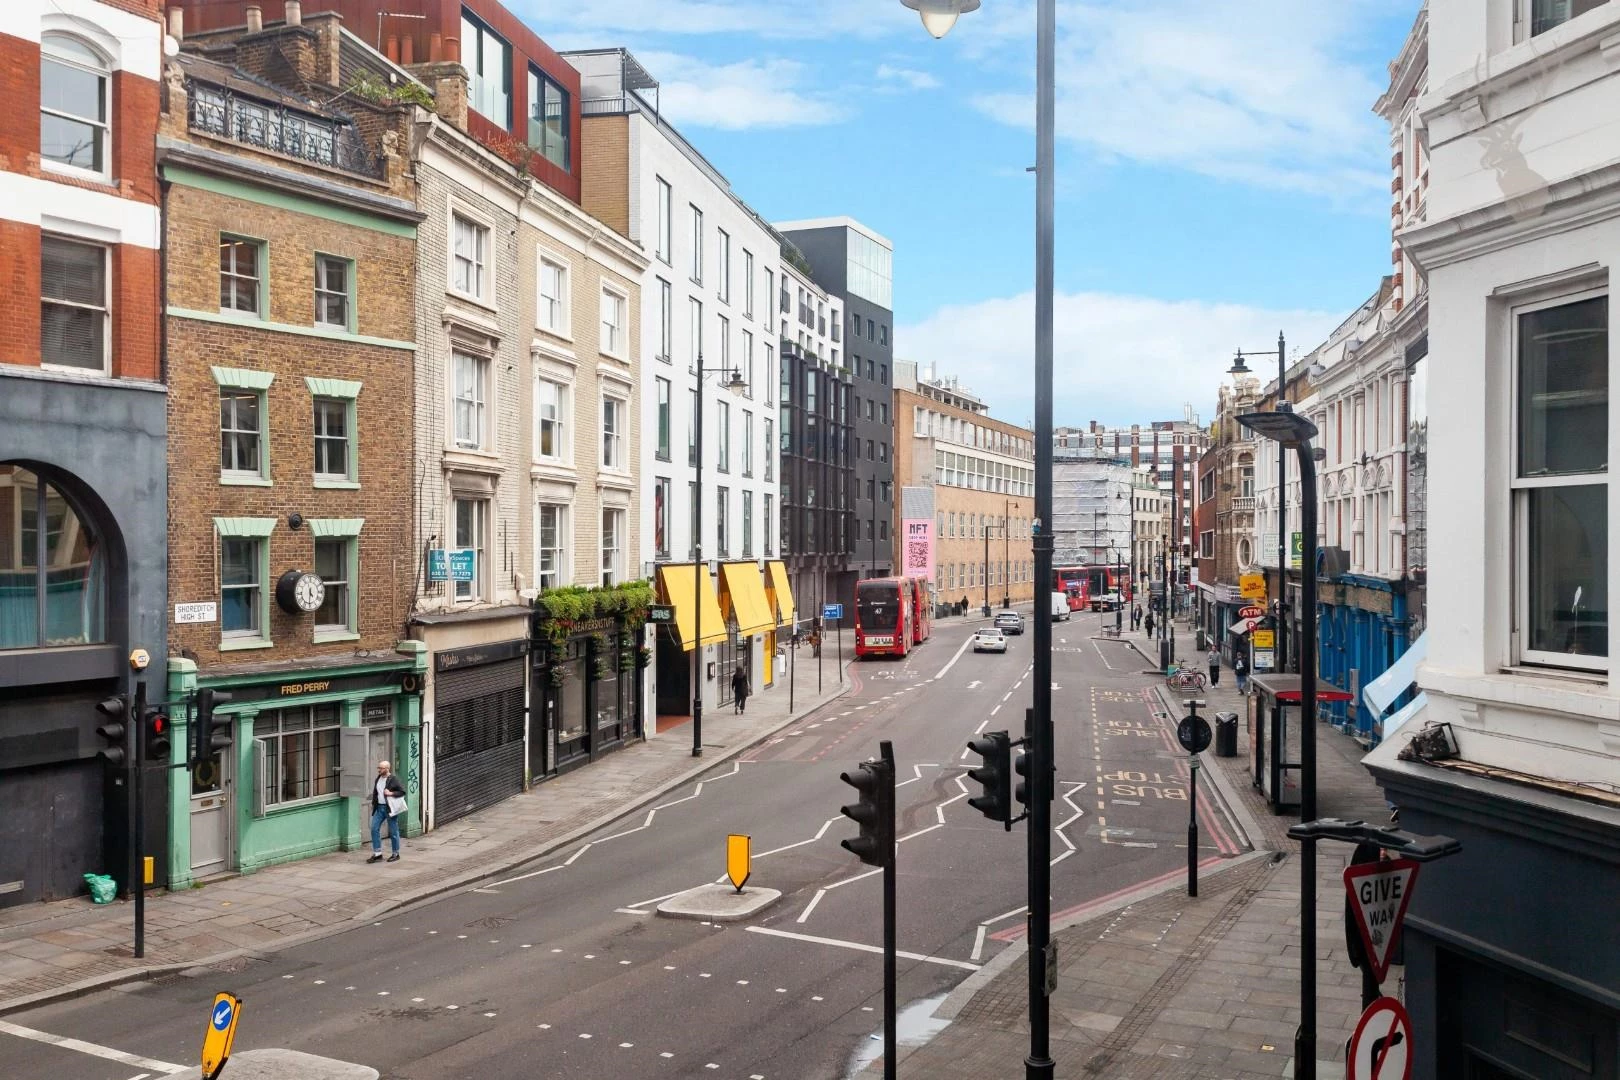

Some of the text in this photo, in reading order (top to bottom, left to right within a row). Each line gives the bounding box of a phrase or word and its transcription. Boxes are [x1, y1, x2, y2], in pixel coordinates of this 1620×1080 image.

[435, 562, 467, 570] TO LET
[177, 604, 214, 614] SHOREDITCH
[1241, 608, 1262, 617] ATM
[180, 612, 206, 621] HIGH ST
[281, 681, 330, 695] FRED PERRY
[1112, 784, 1188, 801] BUS
[1360, 876, 1402, 904] GIVE
[1369, 909, 1394, 926] WAY
